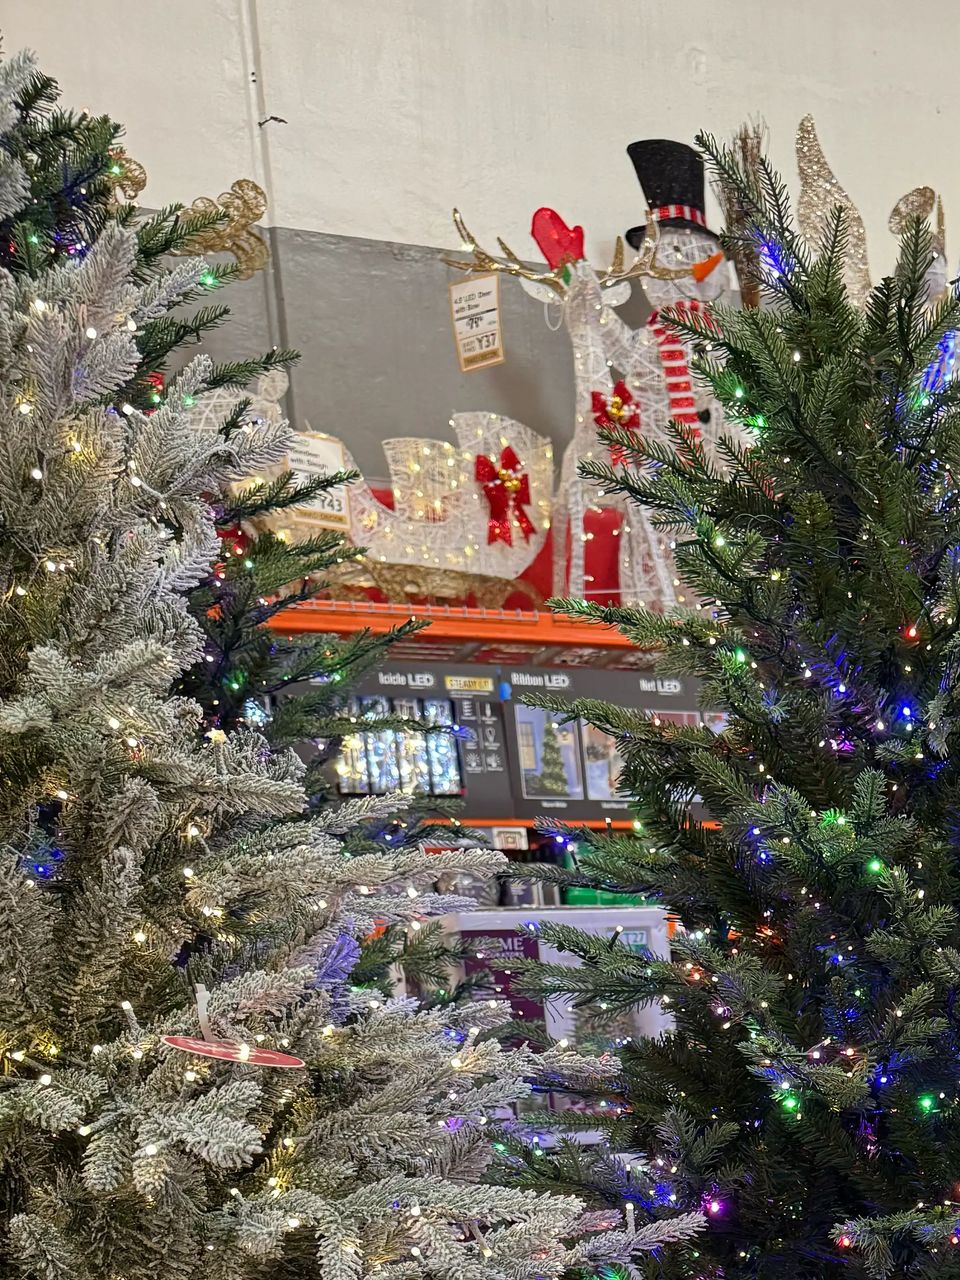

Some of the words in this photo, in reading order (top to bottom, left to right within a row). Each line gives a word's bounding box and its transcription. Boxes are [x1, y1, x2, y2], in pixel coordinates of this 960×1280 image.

[476, 333, 496, 350] Y37
[407, 673, 434, 687] LED
[511, 672, 543, 686] Ribbon
[544, 674, 570, 687] LED
[657, 679, 682, 693] LED
